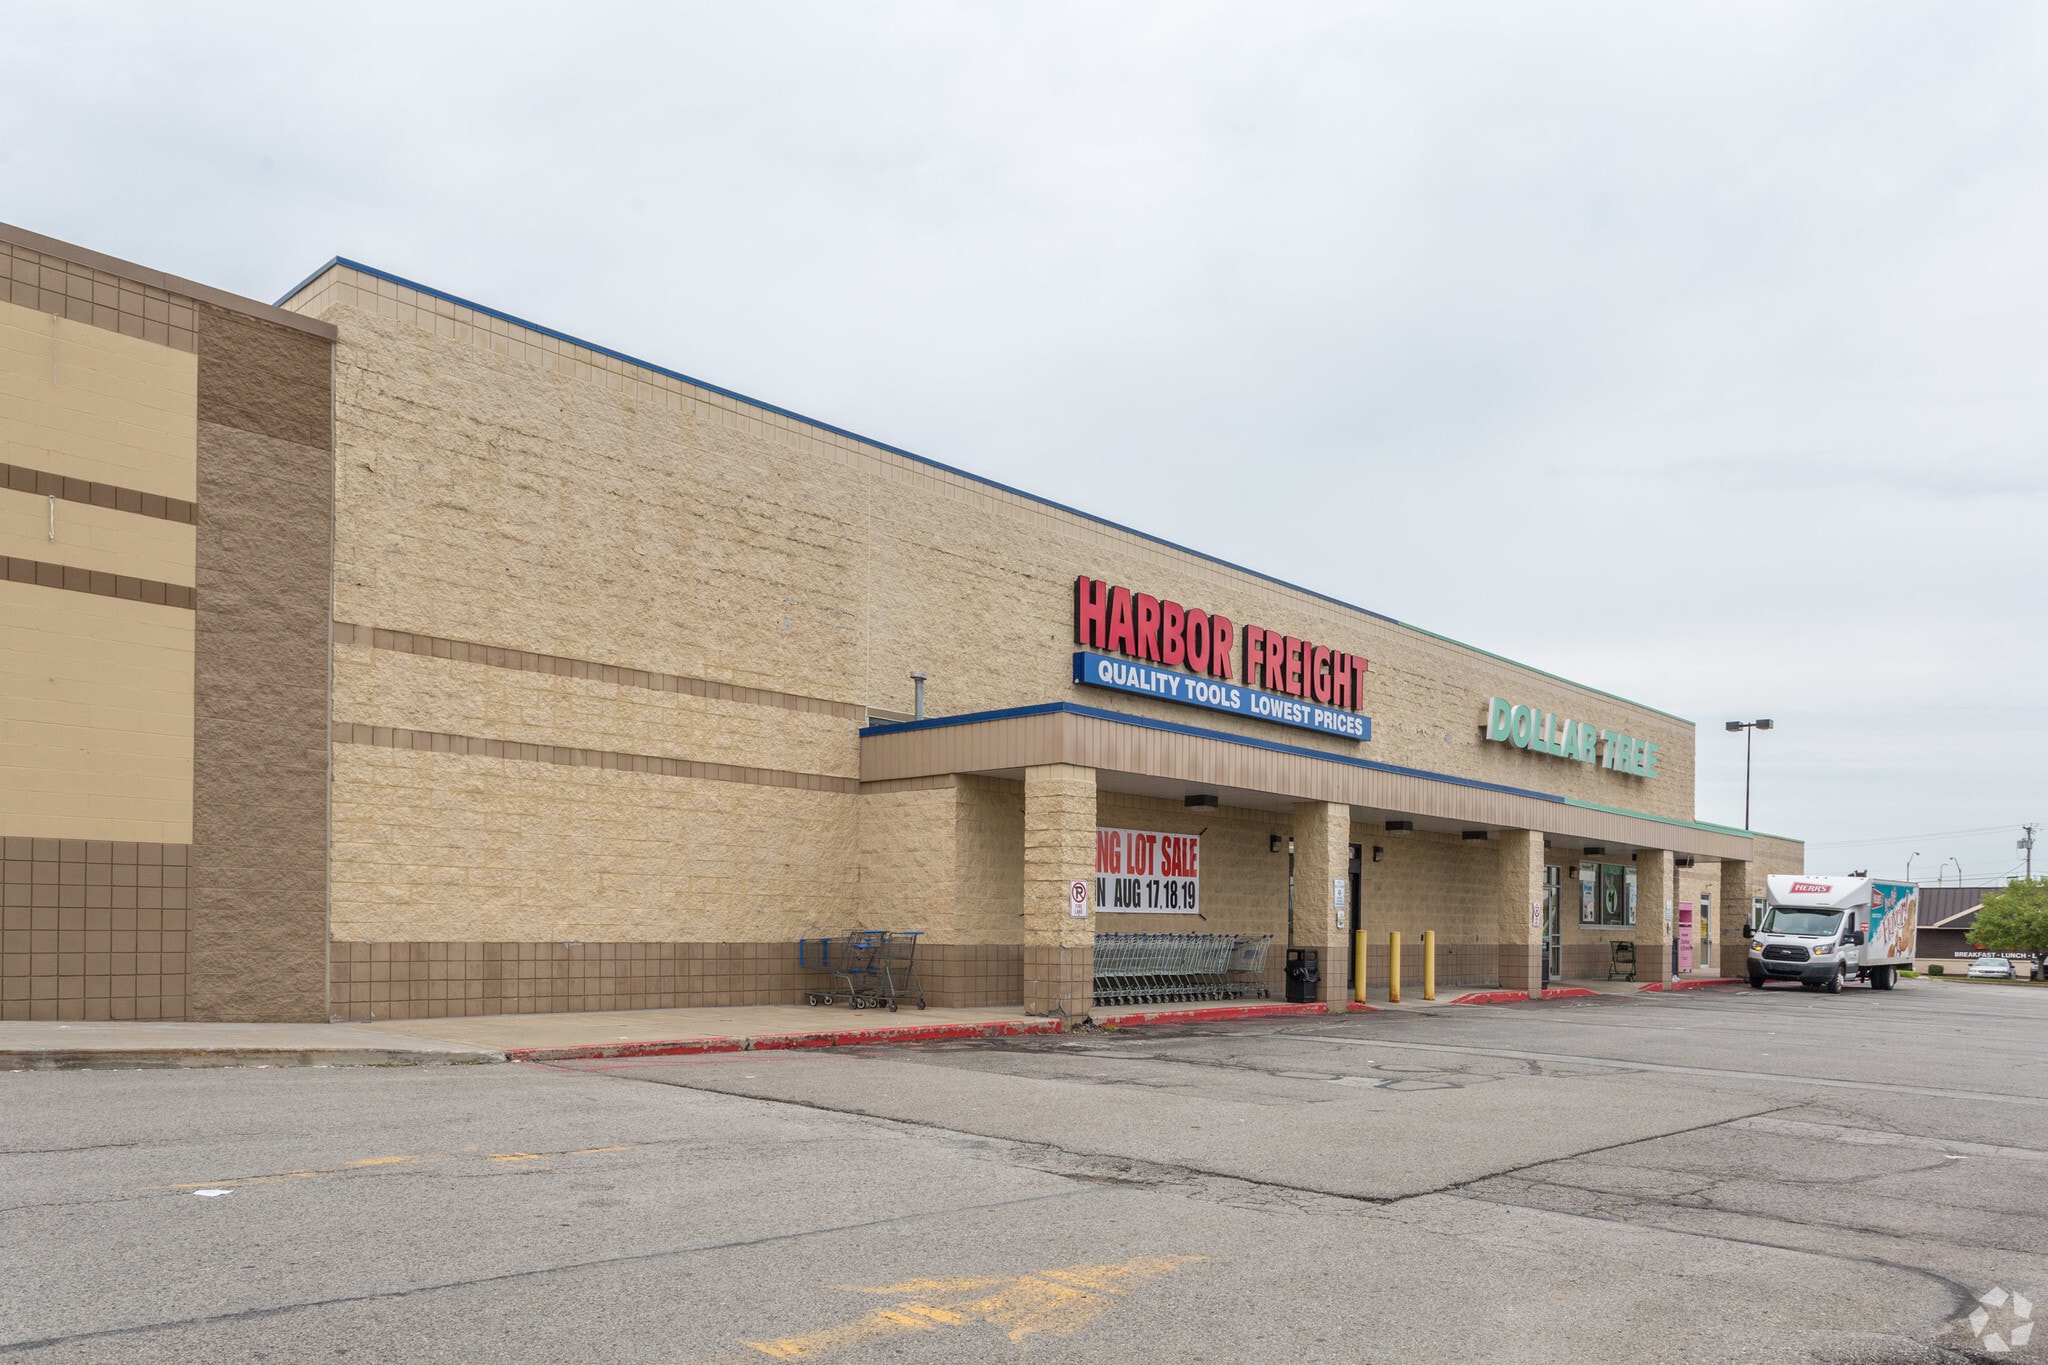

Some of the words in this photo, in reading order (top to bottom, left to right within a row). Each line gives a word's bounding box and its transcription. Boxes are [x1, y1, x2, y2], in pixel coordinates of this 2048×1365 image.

[1074, 575, 1233, 679] HARBOR
[1242, 624, 1369, 711] FREIGHT
[1098, 660, 1180, 696] QUALITY
[1185, 679, 1240, 709] TOOLS
[1251, 694, 1311, 724] LOWEST
[1314, 708, 1363, 736] PRICES
[1486, 696, 1597, 764] DOLLAR
[1601, 729, 1659, 780] TREE
[1126, 832, 1157, 876] LOT
[1161, 835, 1198, 878] SALE
[1113, 878, 1141, 908] AUG
[1794, 884, 1827, 892] HERR'S
